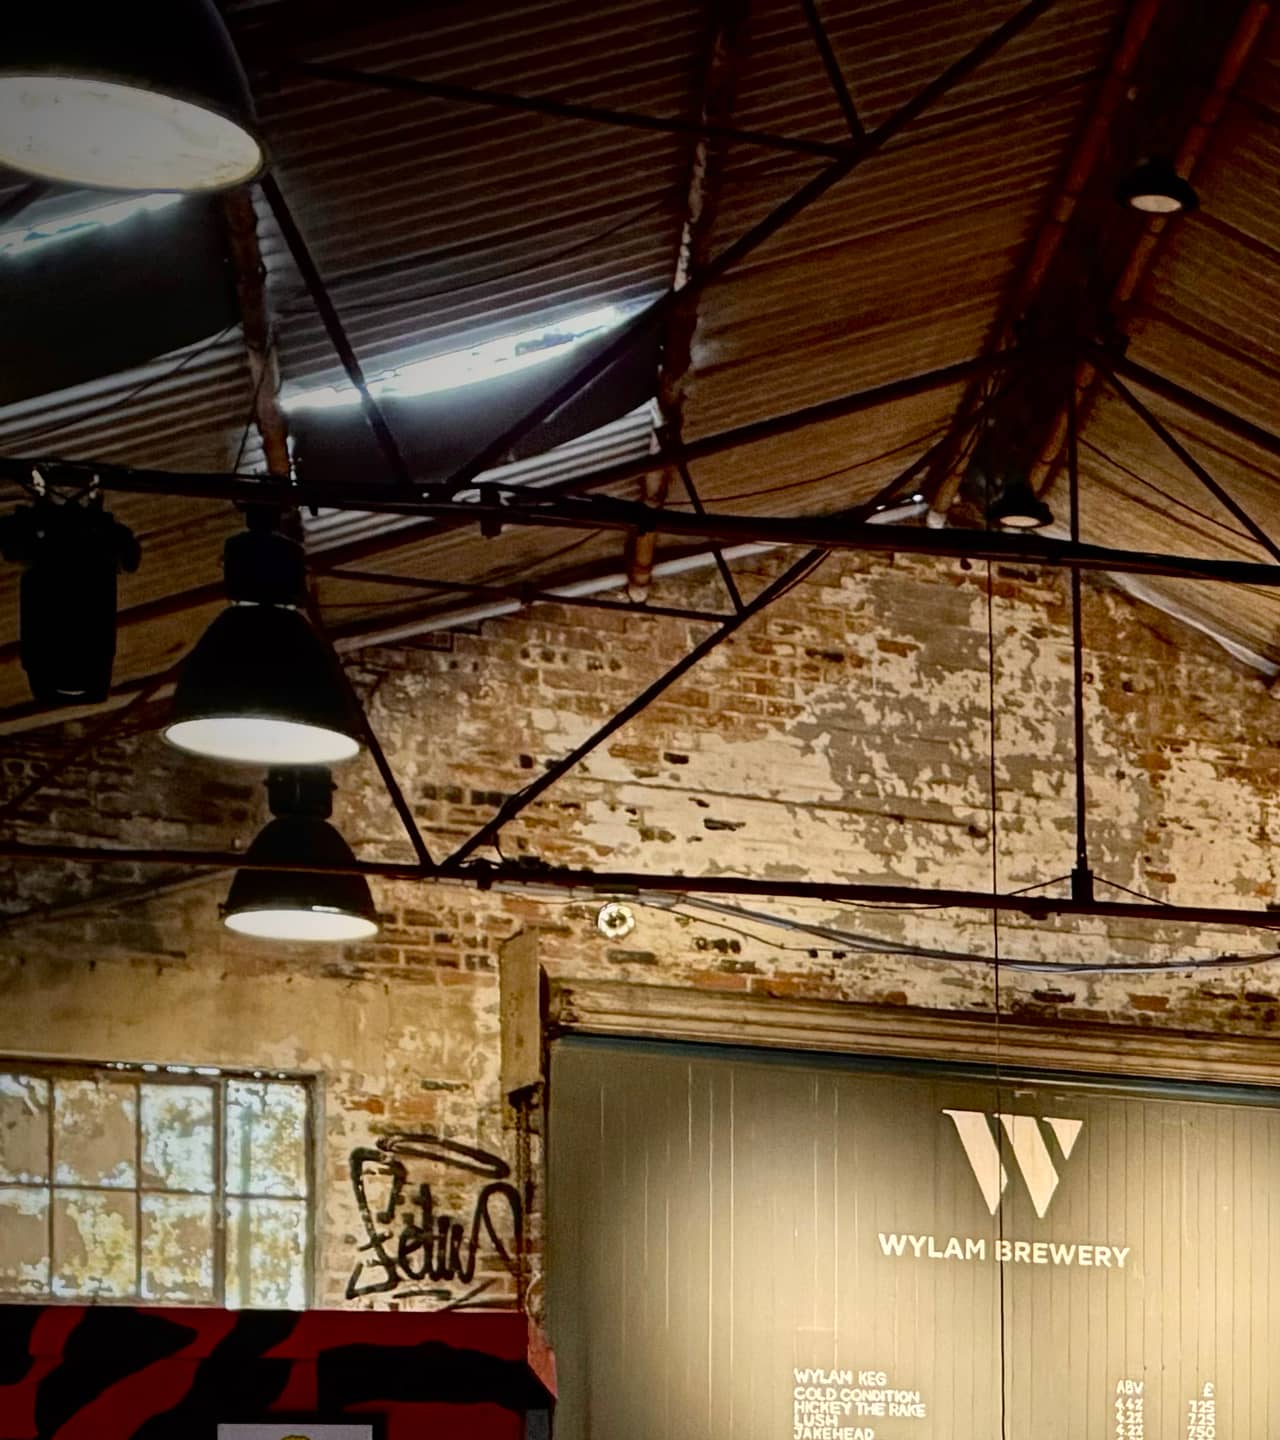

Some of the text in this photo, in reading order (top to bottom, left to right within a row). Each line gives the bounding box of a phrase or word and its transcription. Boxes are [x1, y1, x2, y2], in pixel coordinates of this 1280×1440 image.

[878, 1233, 1131, 1268] WYLAM BREWERY
[793, 1368, 1144, 1395] WYLAM KEG ABV
[794, 1387, 838, 1400] COLD
[840, 1389, 920, 1403] CONDITION
[794, 1400, 852, 1416] HICKEY
[855, 1402, 886, 1417] THE
[889, 1403, 927, 1418] RAKE
[794, 1414, 838, 1428] LUSH
[793, 1426, 875, 1440] JAKEHEAD
